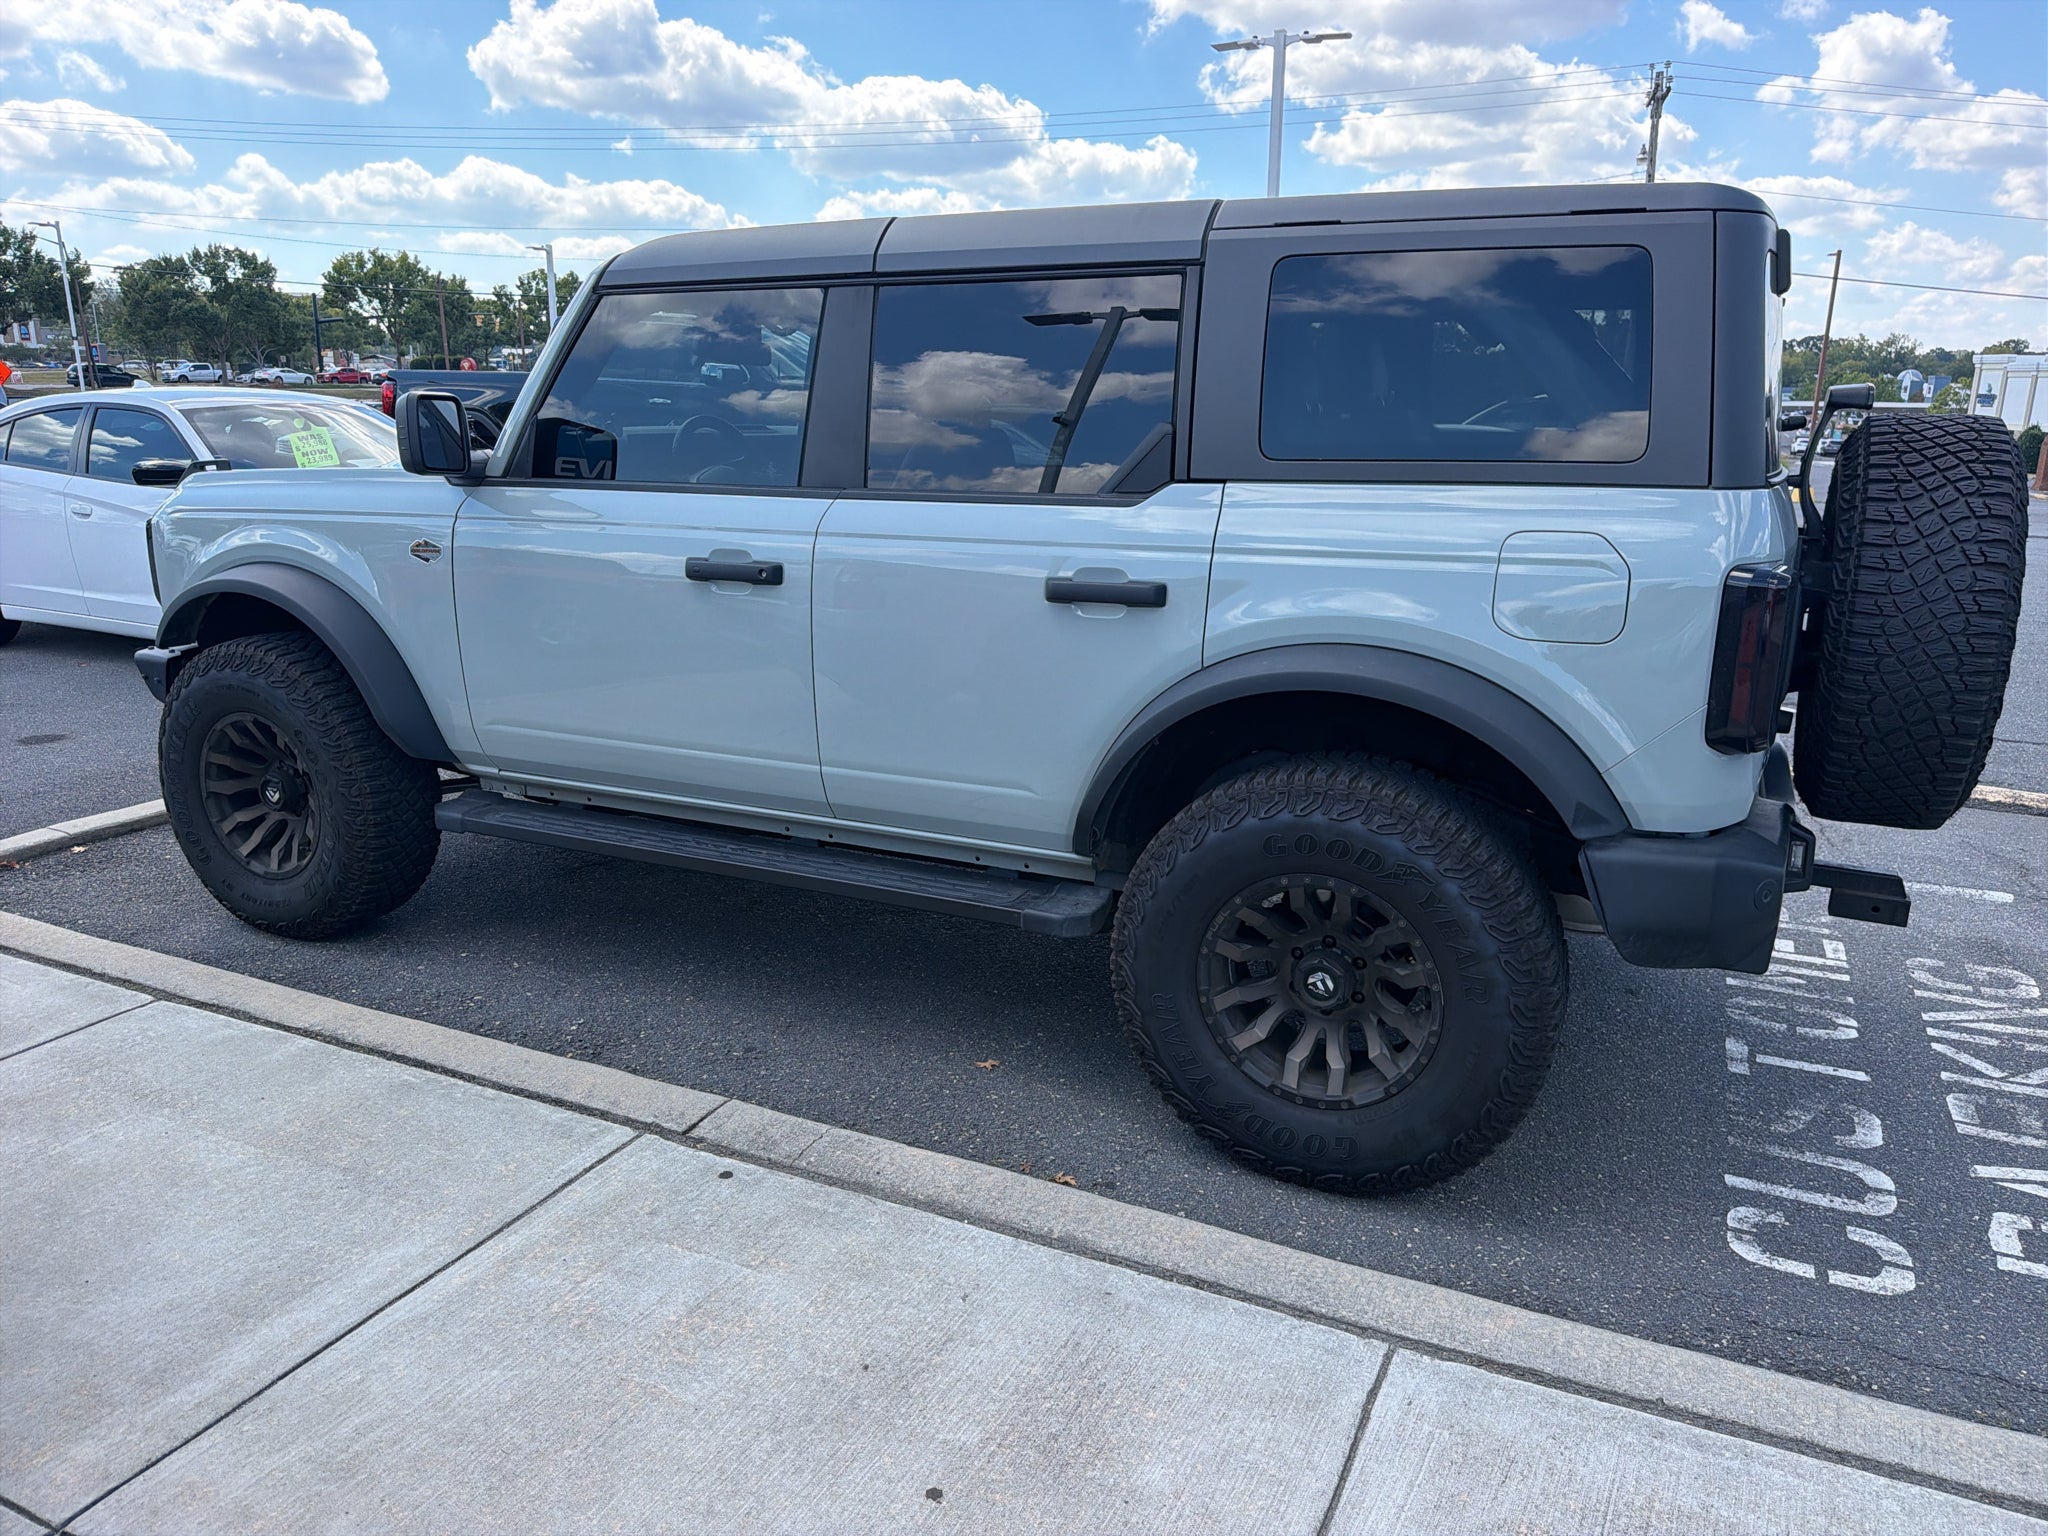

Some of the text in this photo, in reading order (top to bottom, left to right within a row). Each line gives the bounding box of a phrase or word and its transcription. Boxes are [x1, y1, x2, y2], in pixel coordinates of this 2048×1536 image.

[297, 434, 323, 442] WAS
[301, 449, 328, 458] NOW
[1262, 832, 1490, 1006] GOODYEAR
